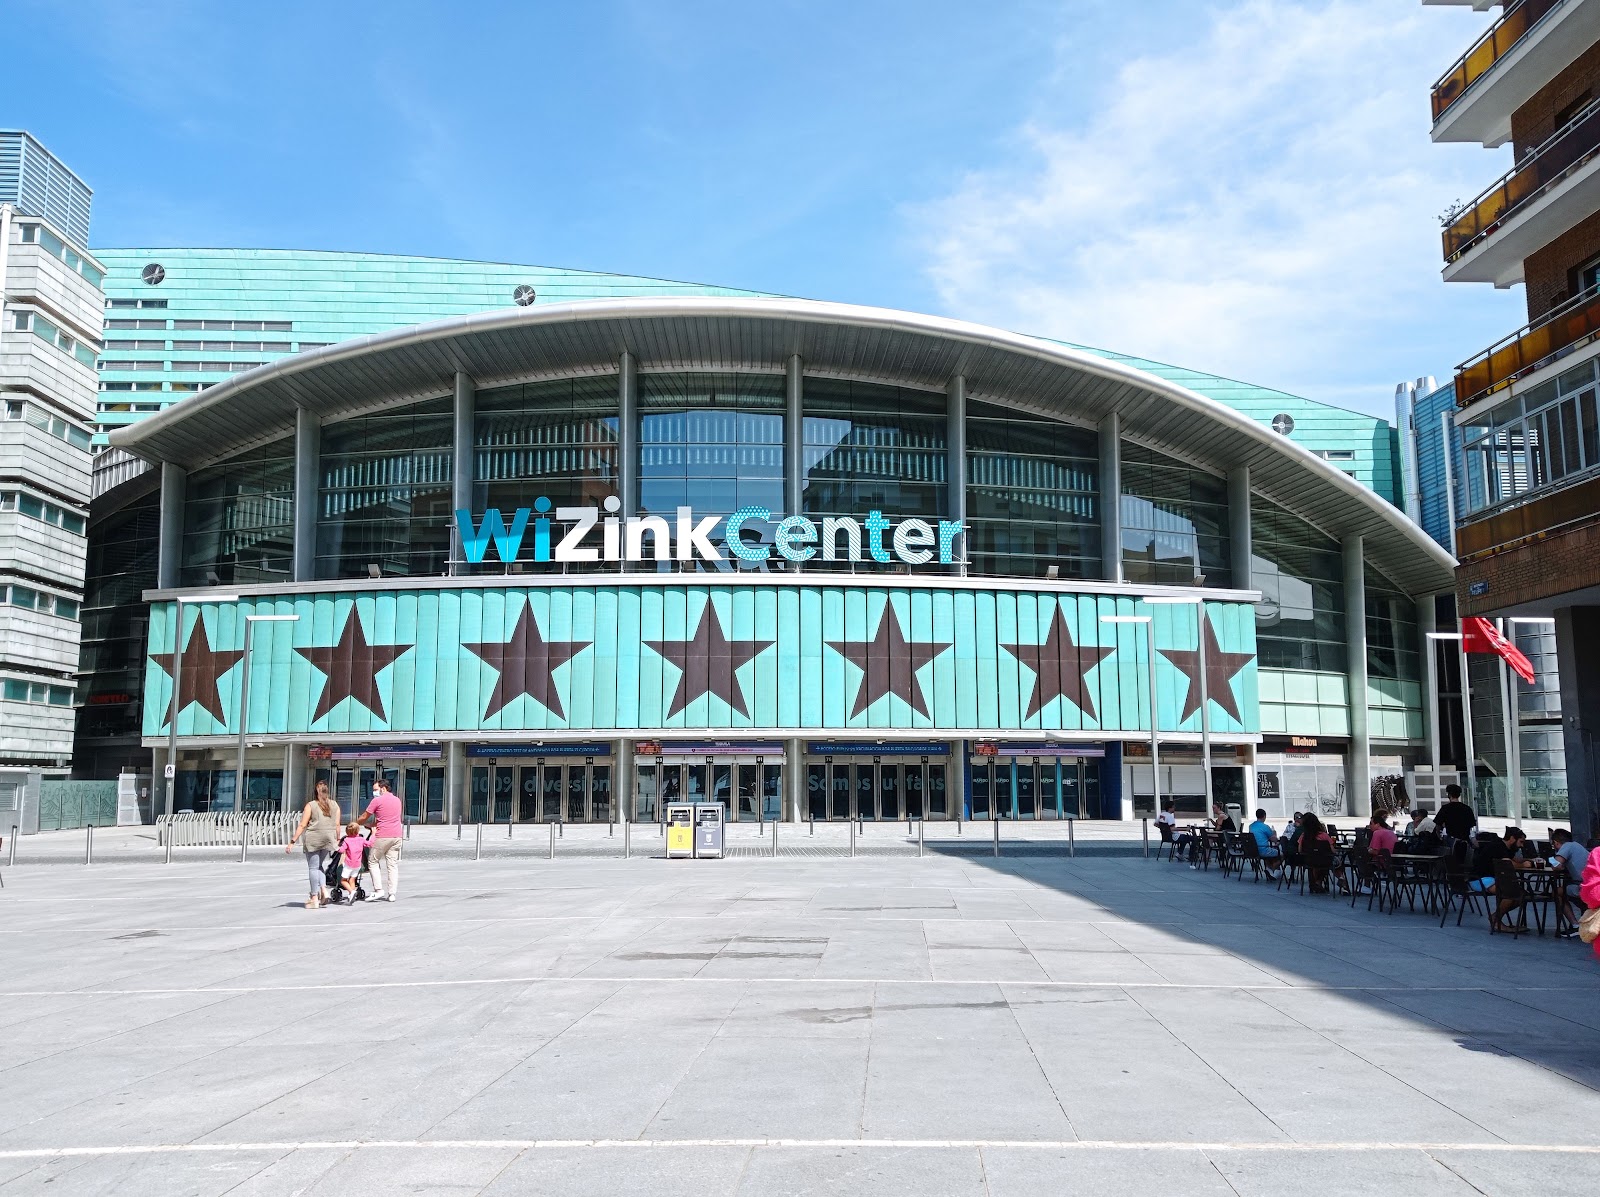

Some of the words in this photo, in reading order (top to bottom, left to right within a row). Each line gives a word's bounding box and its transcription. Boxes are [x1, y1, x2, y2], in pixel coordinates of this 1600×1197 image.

[1292, 737, 1317, 746] Mahou
[472, 776, 513, 793] 100%
[524, 775, 610, 793] dvesión
